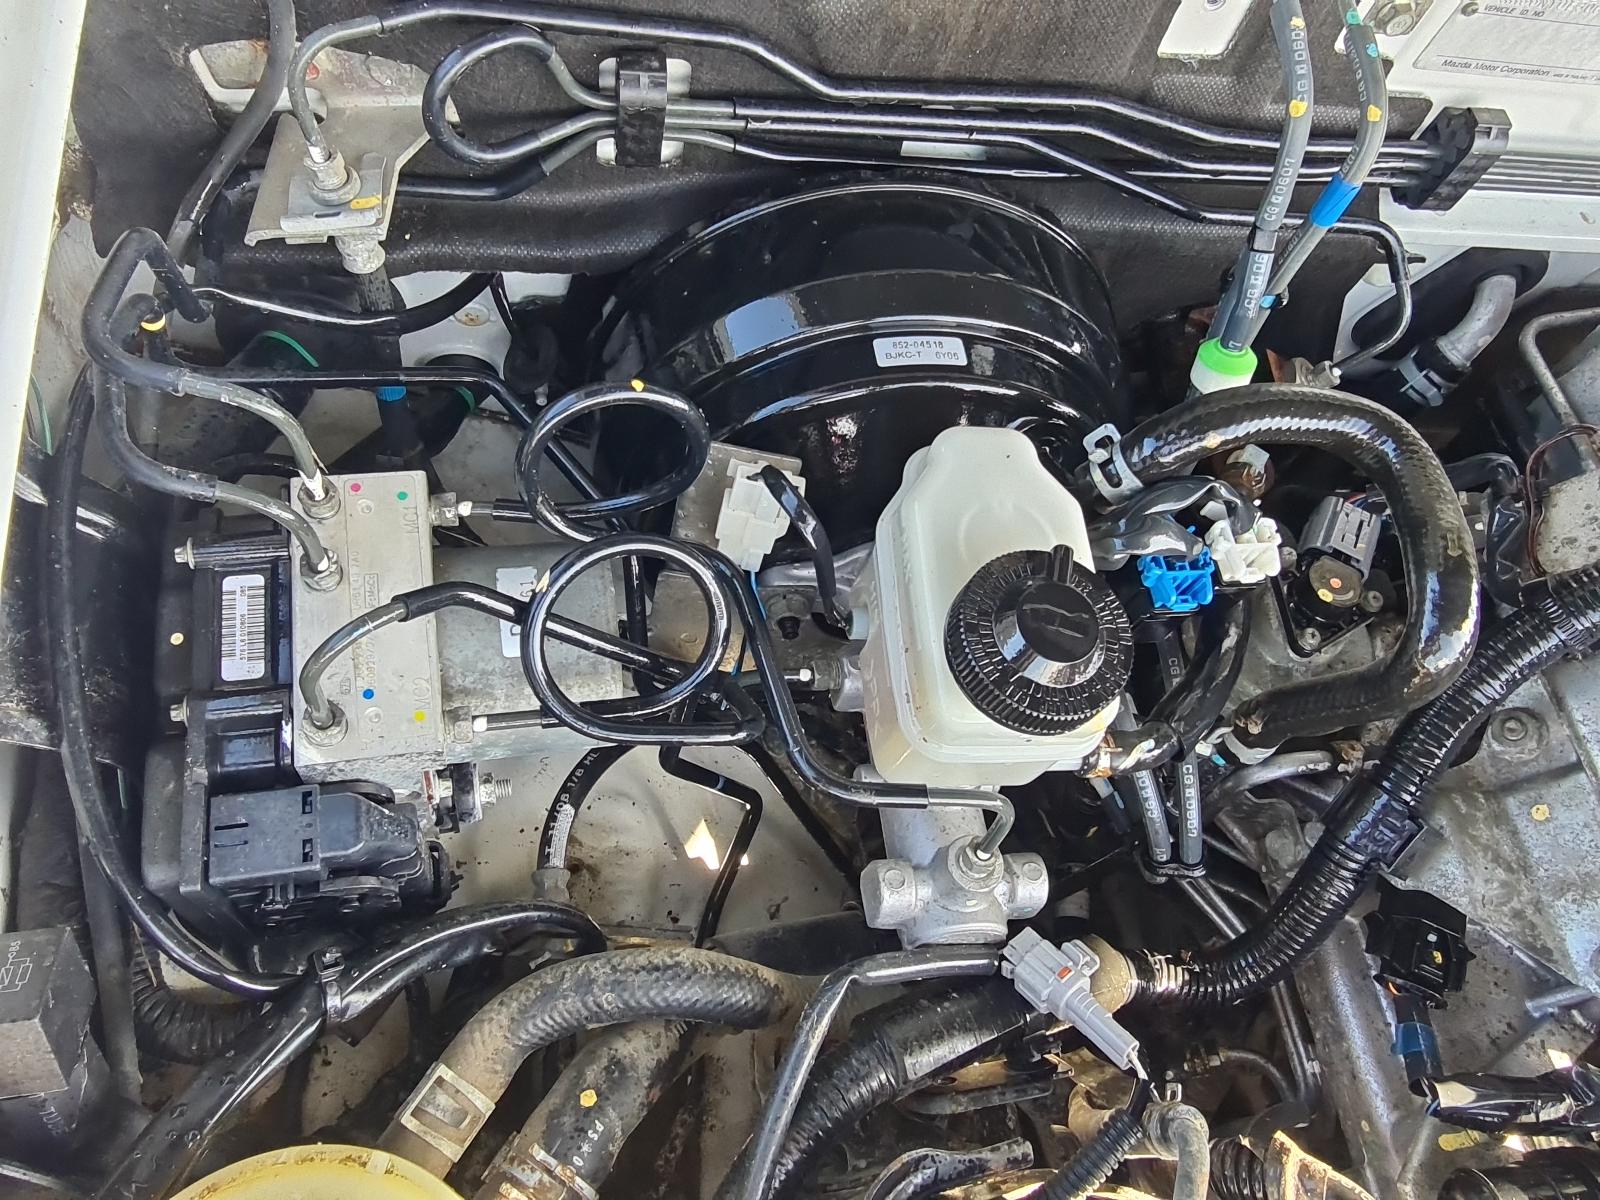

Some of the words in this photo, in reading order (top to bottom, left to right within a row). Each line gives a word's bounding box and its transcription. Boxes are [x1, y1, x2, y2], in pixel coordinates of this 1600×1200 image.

[1484, 4, 1516, 15] VEHICLE
[1519, 8, 1528, 16] ID
[1441, 59, 1471, 70] Mazda
[1473, 62, 1500, 73] Motor
[1500, 65, 1551, 78] Corporation
[885, 351, 922, 360] BJKC-T
